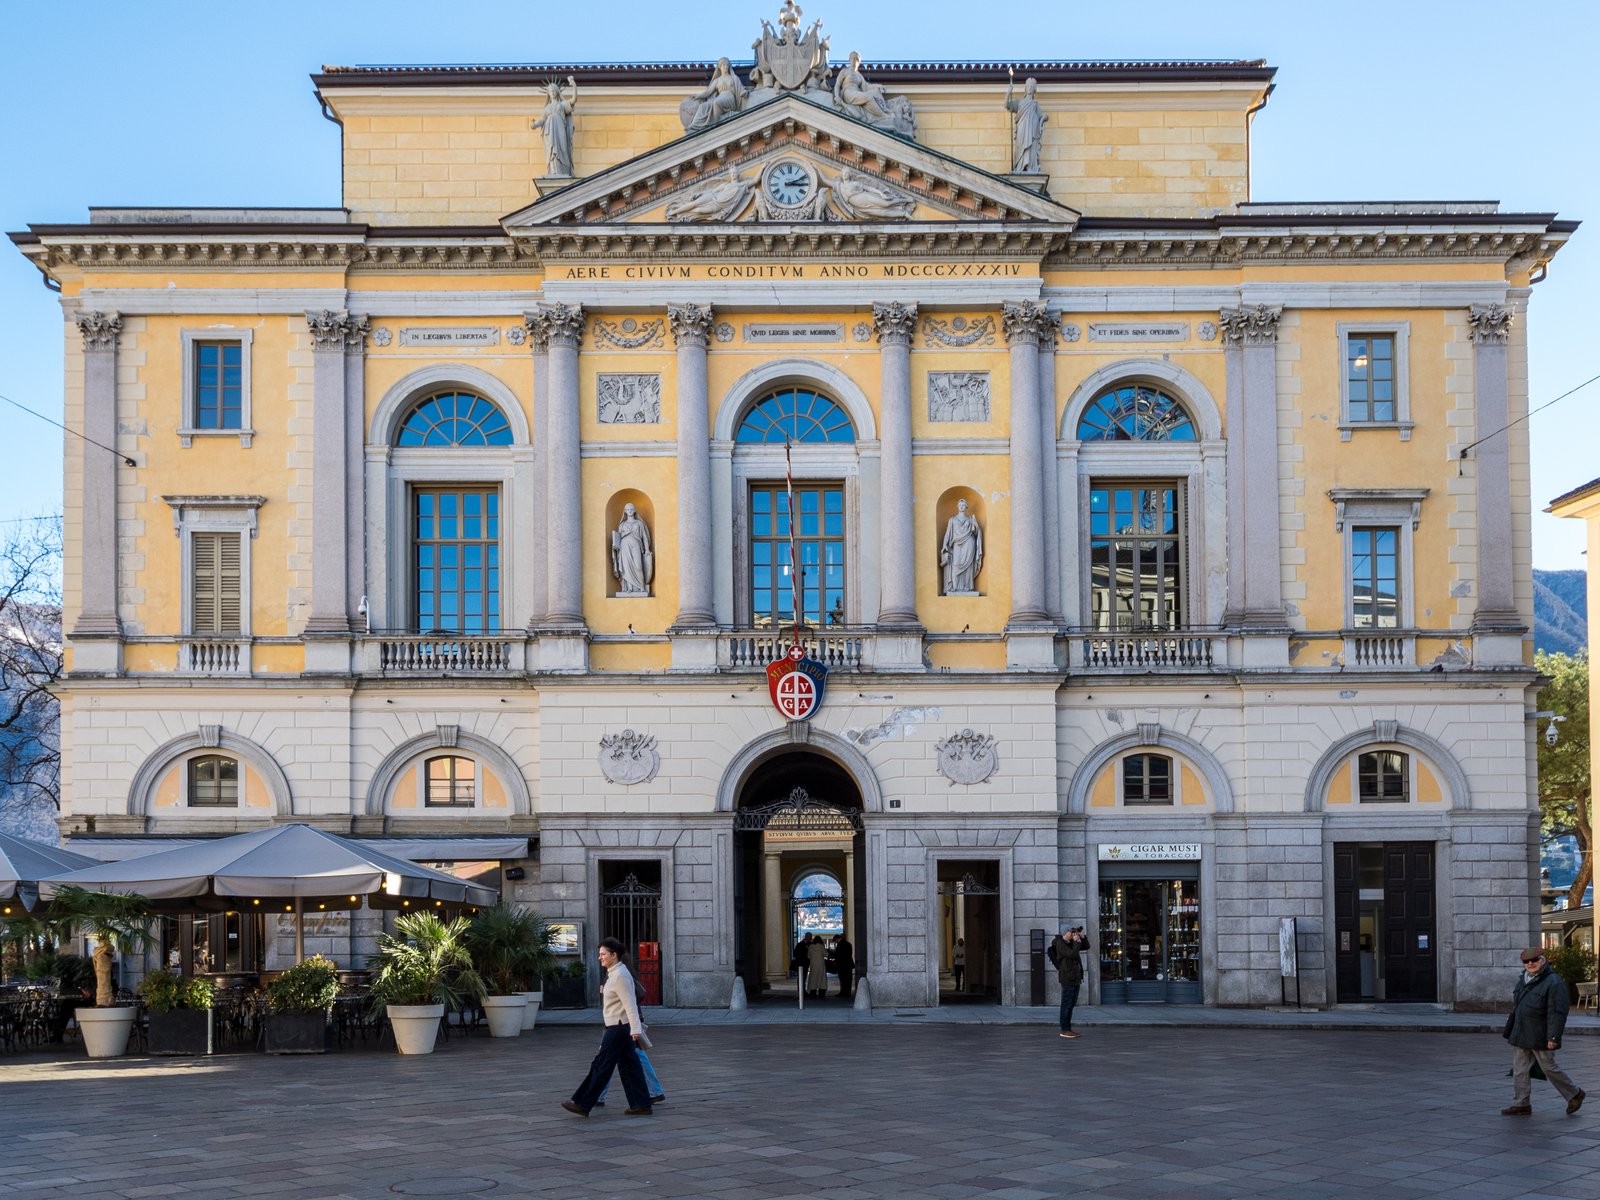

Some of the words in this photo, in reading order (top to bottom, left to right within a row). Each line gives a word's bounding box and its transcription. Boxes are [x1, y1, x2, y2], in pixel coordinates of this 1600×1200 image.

[566, 267, 610, 278] AERE
[626, 266, 691, 278] CIVIVM
[708, 266, 804, 277] CONDITVM
[820, 266, 868, 276] ANNO
[883, 265, 1020, 276] MDCCCXXXXIV
[784, 682, 793, 693] L
[800, 682, 809, 693] V
[783, 698, 794, 709] G
[800, 698, 808, 709] A
[1130, 844, 1165, 852] CIGAR
